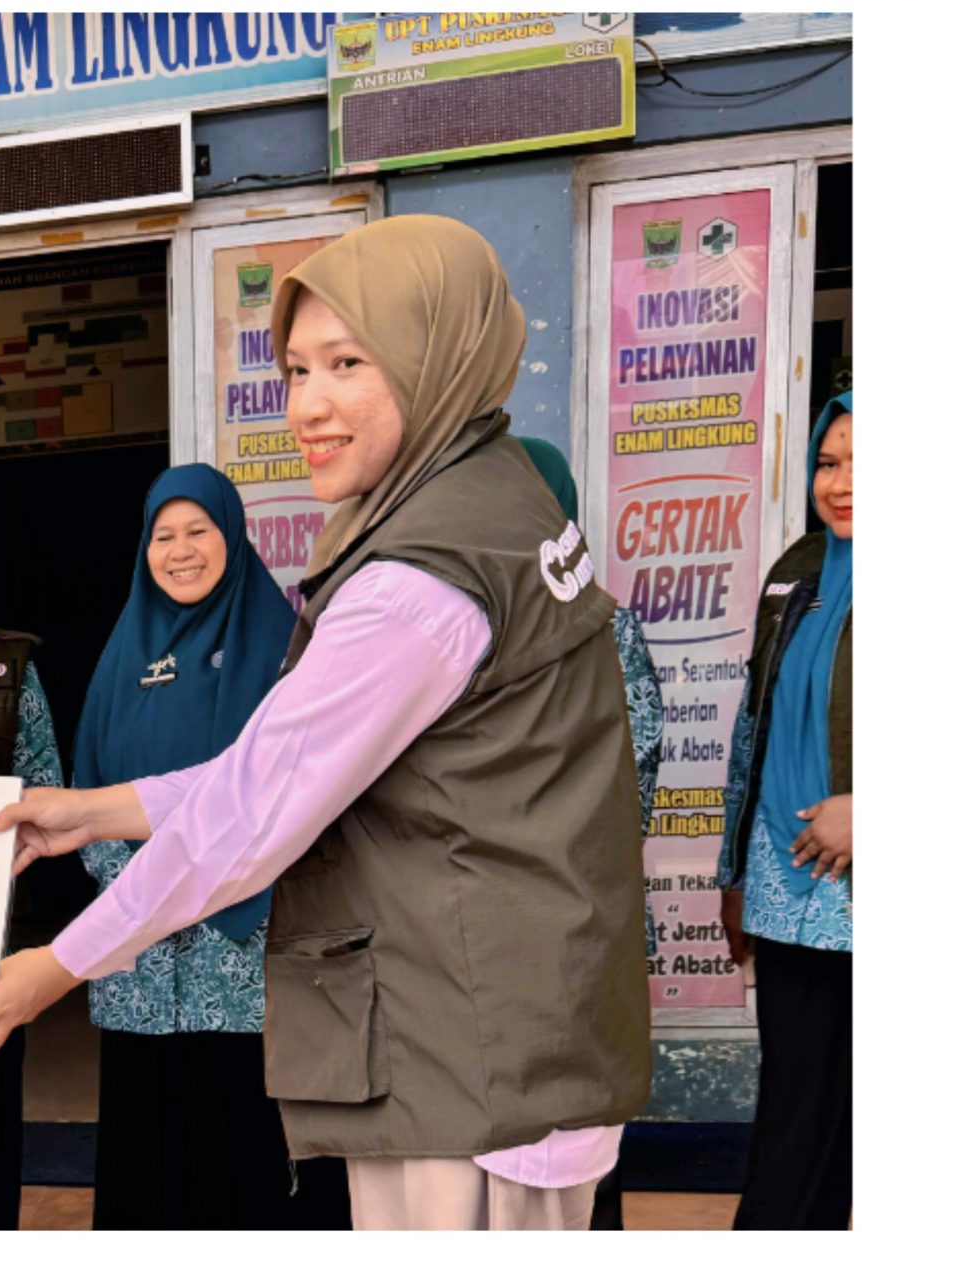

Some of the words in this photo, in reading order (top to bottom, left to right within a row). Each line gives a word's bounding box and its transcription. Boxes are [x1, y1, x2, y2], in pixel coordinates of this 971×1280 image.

[385, 14, 432, 42] UPT
[412, 38, 461, 56] ENAM
[464, 21, 555, 48] LINGKUNG
[353, 66, 427, 91] ANTRIAN
[564, 39, 615, 60] LOKET
[636, 283, 740, 331] INOVASI
[617, 337, 757, 385] PELAYANAN
[227, 378, 288, 417] PELAY
[630, 393, 741, 425] PUSKESMAS
[238, 430, 301, 457] PUSKES
[614, 428, 665, 455] ENAM
[667, 421, 758, 452] LINGKUNG
[268, 457, 311, 482] LINGK
[615, 491, 752, 562] GERTAK
[630, 562, 734, 625] ABATE
[680, 735, 725, 763] Abate
[652, 786, 726, 808] skesmas
[660, 814, 726, 838] Lingku
[678, 874, 718, 893] Teka
[671, 921, 727, 942] Jenti
[671, 953, 736, 976] Abate
